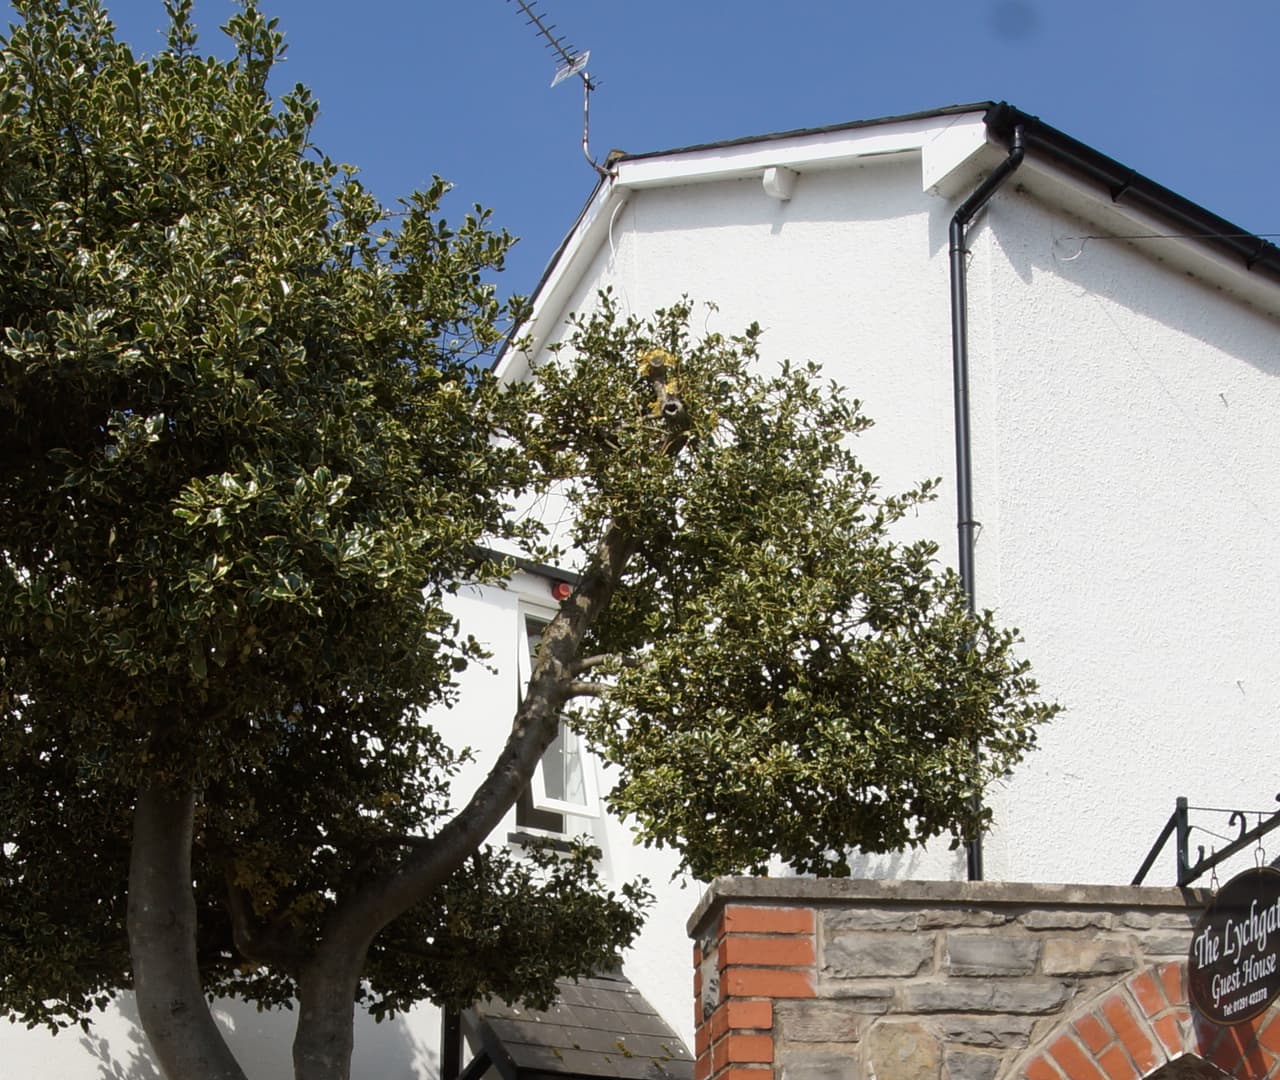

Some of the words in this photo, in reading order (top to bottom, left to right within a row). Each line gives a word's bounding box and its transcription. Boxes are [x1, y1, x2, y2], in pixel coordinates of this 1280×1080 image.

[1195, 925, 1219, 969] The
[1212, 967, 1241, 1009] Guest
[1242, 953, 1276, 987] House
